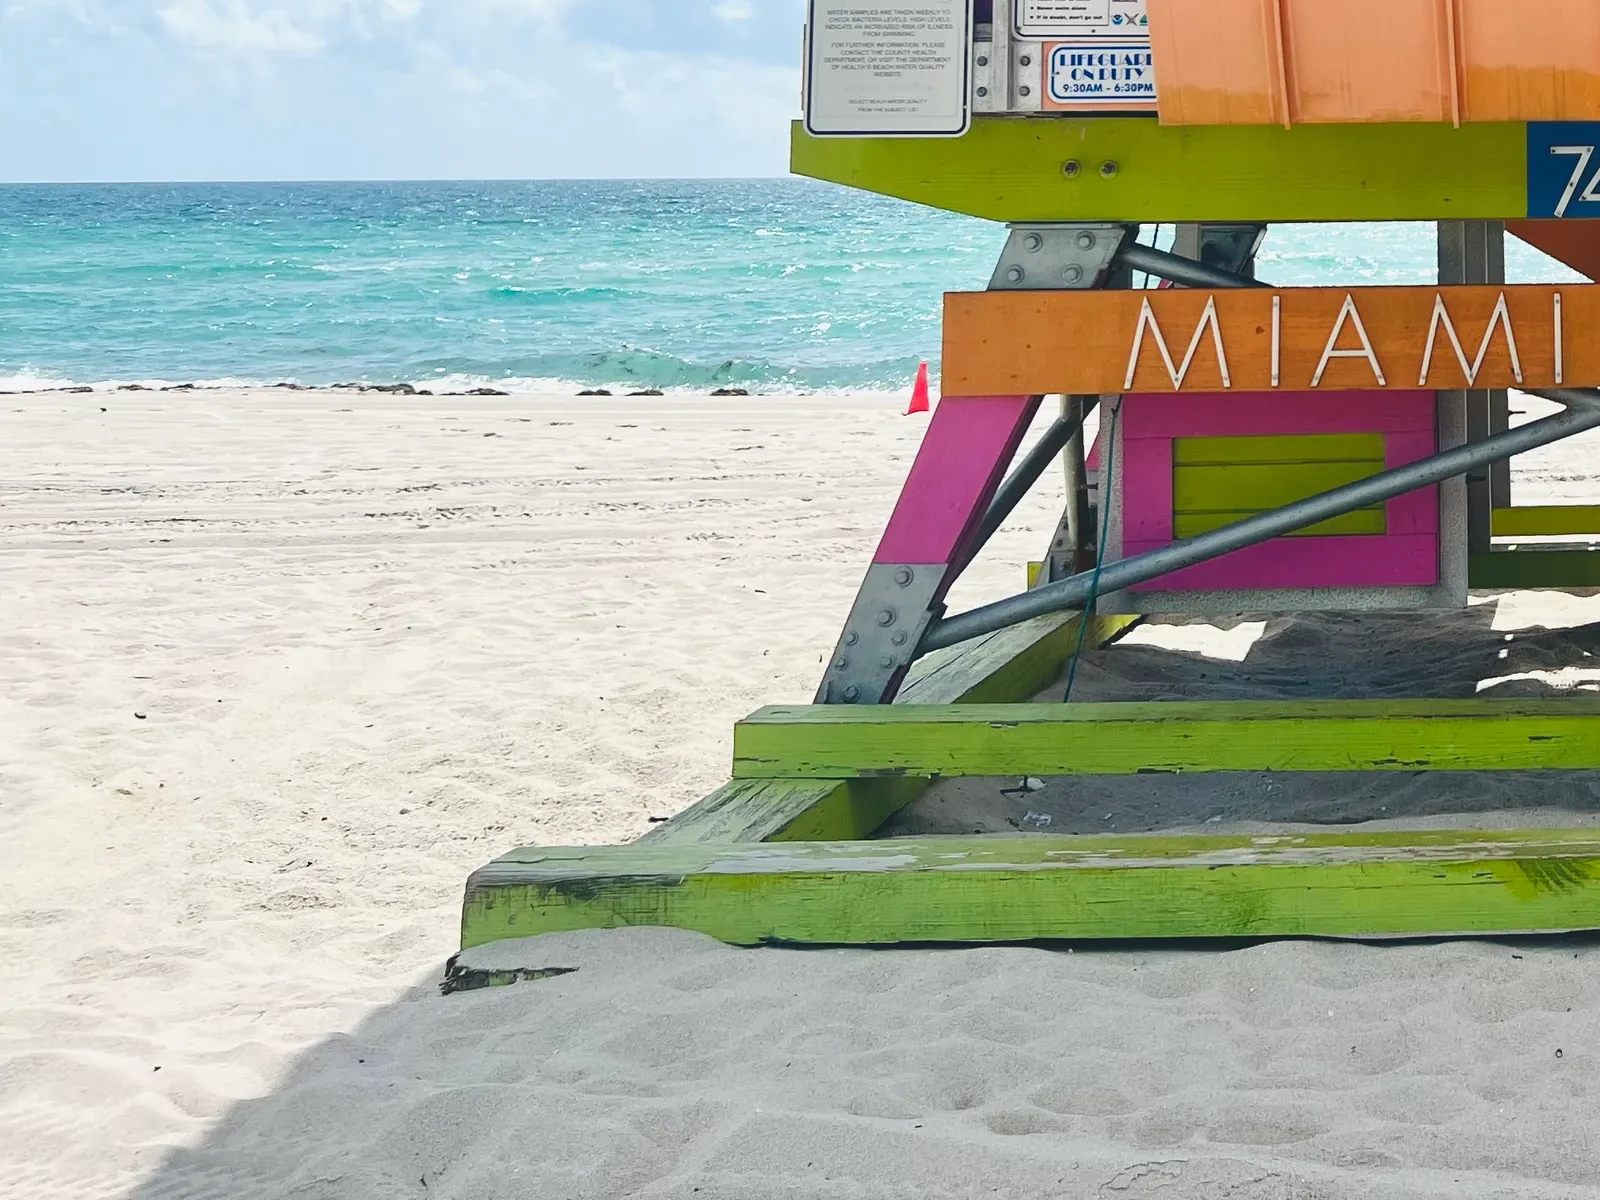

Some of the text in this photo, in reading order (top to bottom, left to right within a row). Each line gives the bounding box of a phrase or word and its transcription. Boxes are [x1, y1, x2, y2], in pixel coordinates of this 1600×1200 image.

[1071, 68, 1145, 80] ON DUTY
[1062, 83, 1103, 92] 9:30AM
[1114, 83, 1153, 92] 6:30PM
[1123, 291, 1563, 391] MIAMI
